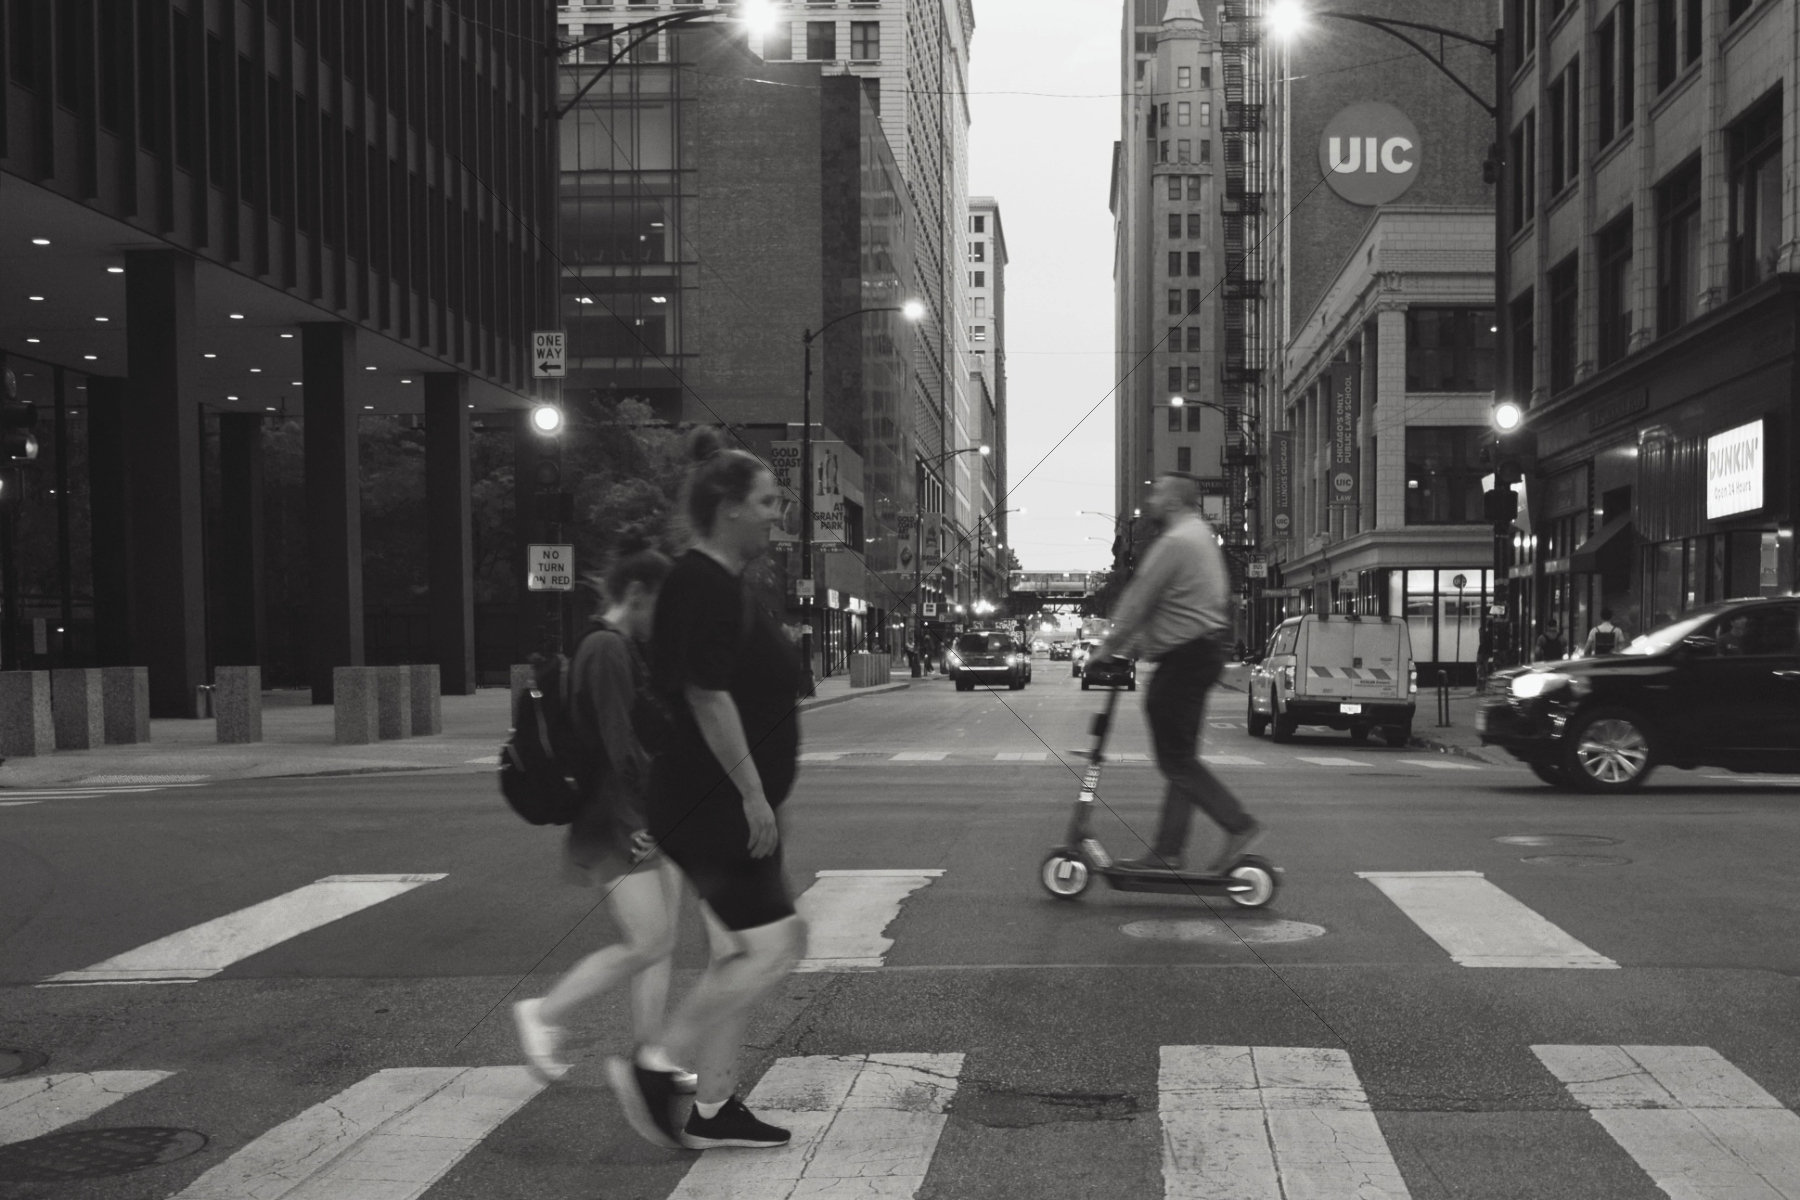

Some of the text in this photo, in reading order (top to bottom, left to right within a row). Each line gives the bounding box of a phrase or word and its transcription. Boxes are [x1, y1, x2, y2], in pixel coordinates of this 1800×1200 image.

[1329, 136, 1413, 174] UIC
[537, 335, 562, 346] ONE
[536, 348, 562, 359] WAY
[1344, 375, 1352, 464] PUBLIC LAW SCHOOL
[1336, 392, 1344, 464] CHICAGO'S ONLY
[771, 448, 799, 458] GOLD
[772, 458, 802, 468] COAST
[1709, 437, 1758, 481] DUNKIN'
[1336, 479, 1352, 487] UIC
[834, 503, 845, 511] AT
[813, 512, 844, 521] GRANT
[821, 521, 843, 531] PARK
[543, 550, 560, 560] NO
[538, 563, 565, 572] TURN
[551, 575, 571, 585] RED
